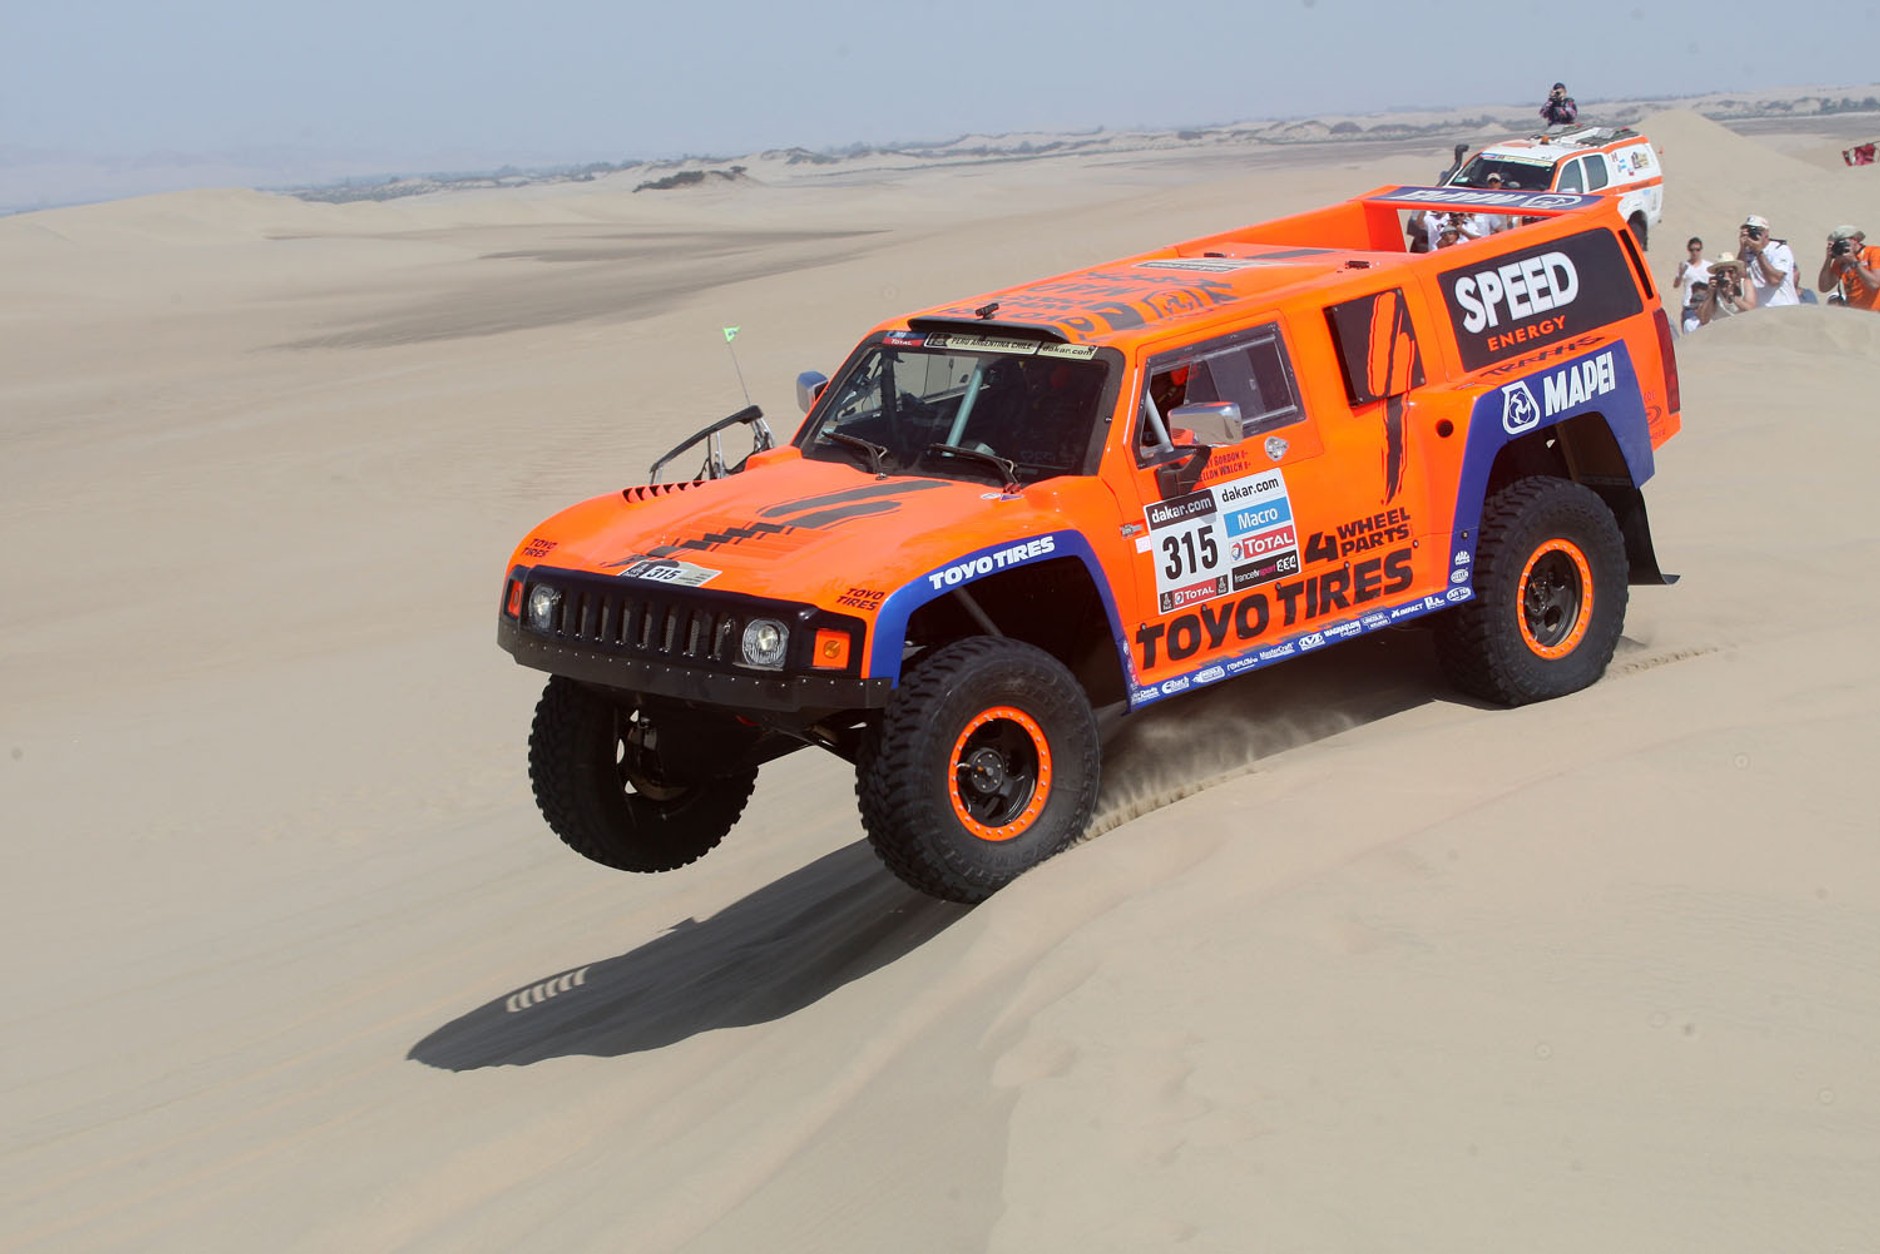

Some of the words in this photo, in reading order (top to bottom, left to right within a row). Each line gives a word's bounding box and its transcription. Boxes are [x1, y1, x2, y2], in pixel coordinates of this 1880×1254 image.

[1455, 252, 1579, 333] SPEED
[1487, 316, 1566, 351] ENERGY
[1543, 351, 1616, 417] MAPEI
[1222, 477, 1279, 502] dakar.com
[1152, 495, 1212, 523] dakar.com
[1238, 507, 1278, 530] Macro
[1244, 527, 1293, 555] TOTAL
[1304, 531, 1338, 564] 4
[1336, 507, 1410, 540] WHEEL
[1341, 524, 1410, 556] PARTS
[929, 557, 993, 590] TOYO
[993, 536, 1055, 567] TIRES
[1163, 525, 1218, 579] 315
[647, 567, 681, 580] 315
[836, 596, 879, 611] TIRES
[846, 588, 885, 600] TOYO
[1185, 586, 1214, 600] TOTAL
[1136, 597, 1269, 670] TOYO
[1276, 549, 1414, 626] TIRES
